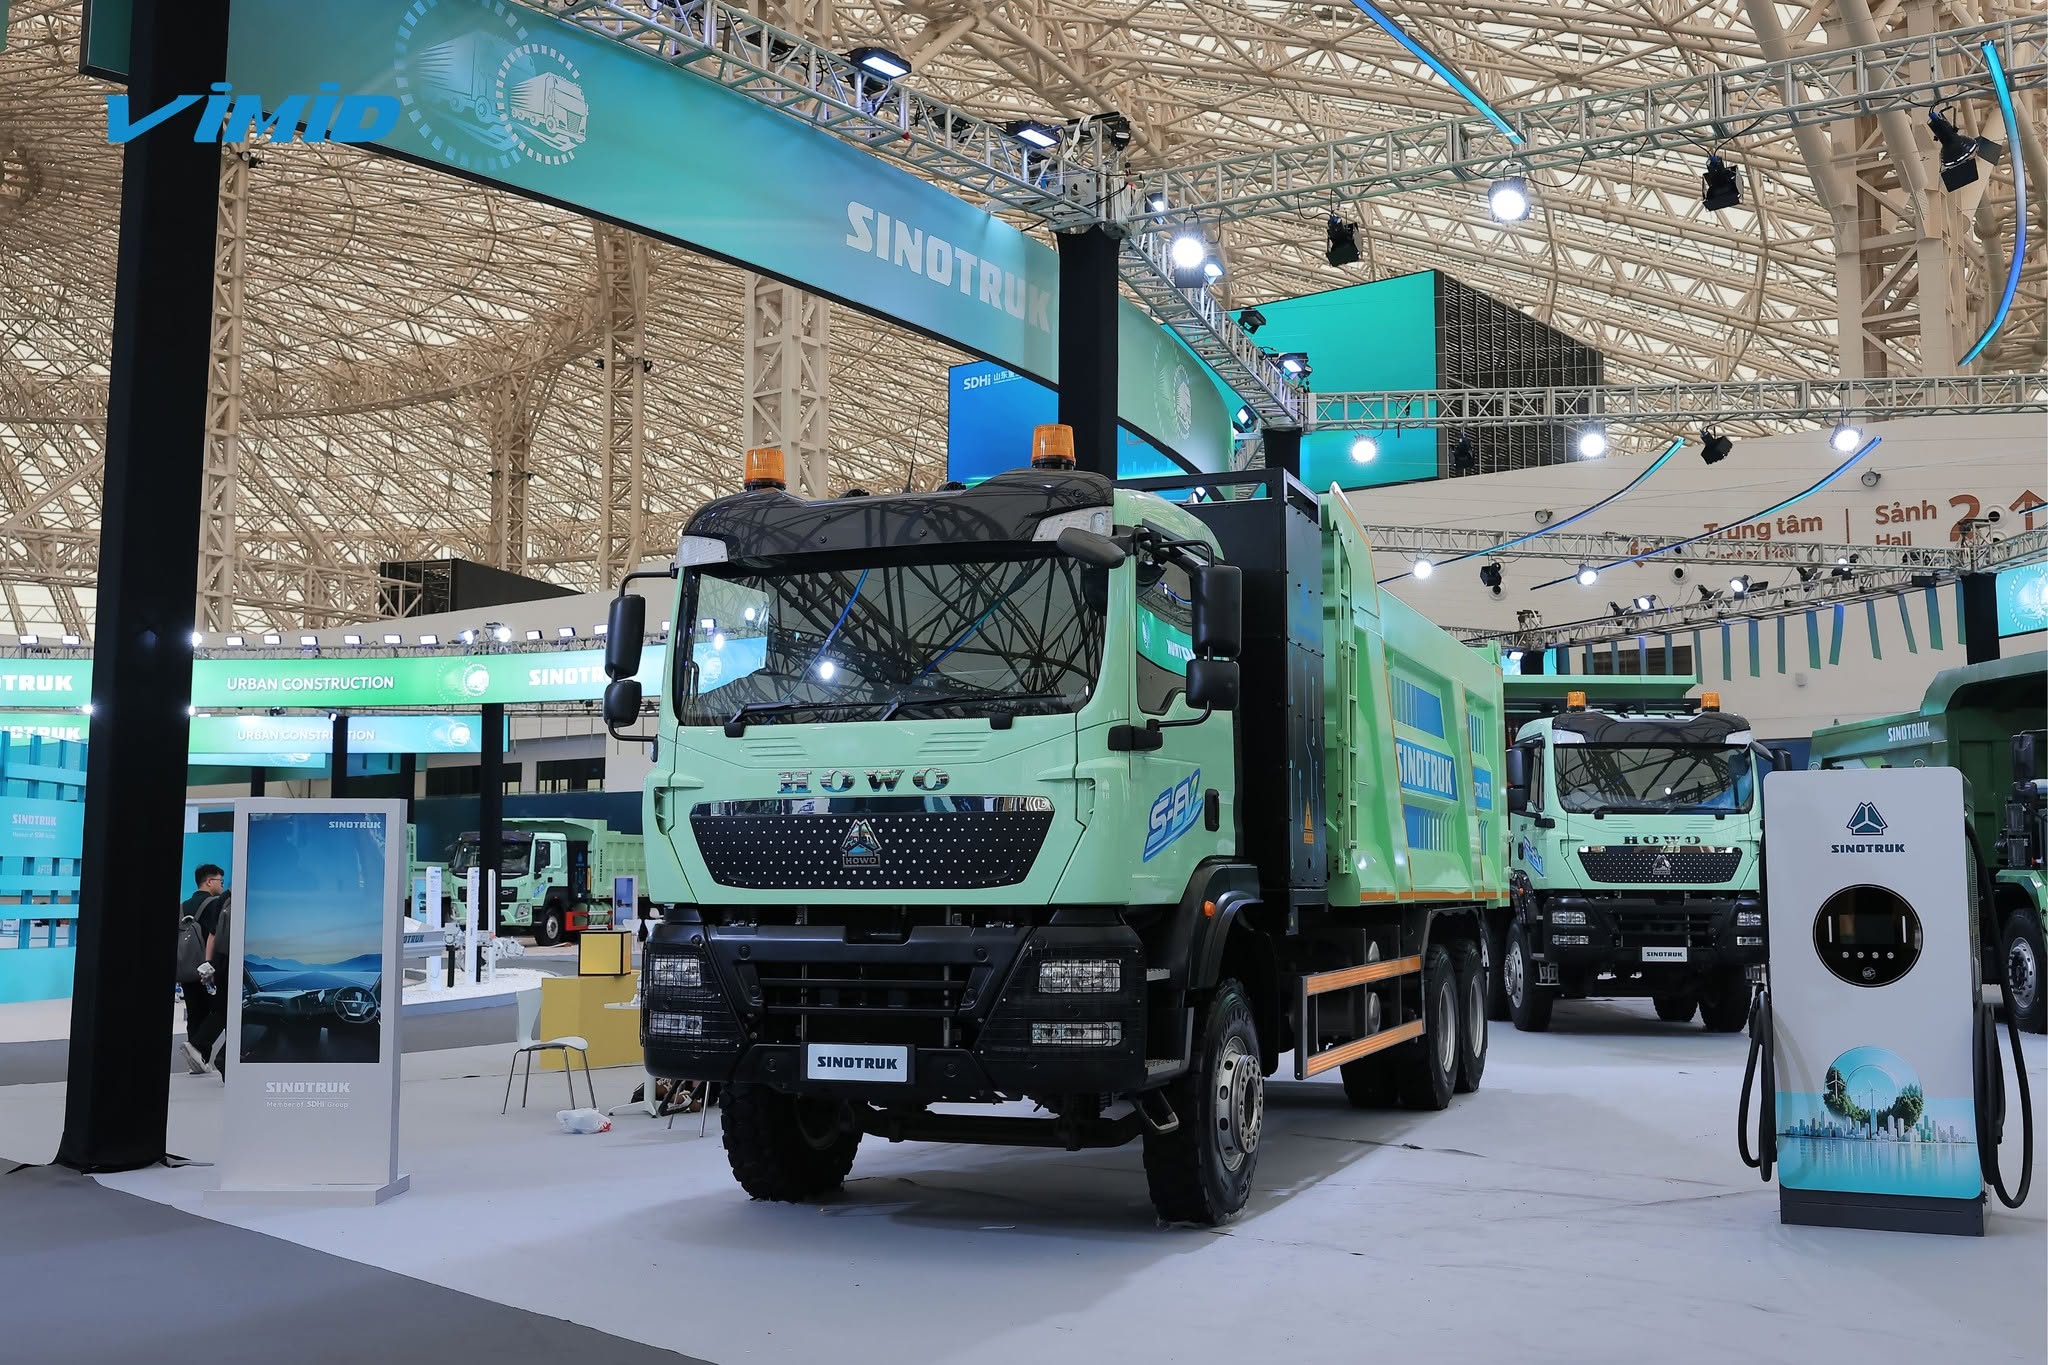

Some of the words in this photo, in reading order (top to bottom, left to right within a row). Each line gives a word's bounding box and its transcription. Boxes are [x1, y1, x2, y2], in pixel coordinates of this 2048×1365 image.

[846, 201, 1050, 332] SINOTRUK
[1875, 500, 1937, 525] Sảnh
[1776, 514, 1823, 535] tâm
[0, 675, 73, 691] TRUK
[226, 677, 278, 691] URBAN
[281, 675, 395, 691] CONSTRUCTION
[528, 665, 611, 686] SINOTR
[236, 730, 279, 741] URBAN
[1887, 721, 1930, 742] SINOTRUK
[1396, 743, 1453, 795] SINOTRUK
[777, 767, 950, 794] HOWO
[328, 821, 381, 829] SINOTRUK
[1622, 835, 1702, 845] HOWO
[1831, 843, 1905, 853] SINOTRUK
[845, 857, 877, 865] HOWO
[817, 1056, 898, 1070] SINOTRUK
[265, 1082, 350, 1093] SINOTRUK
